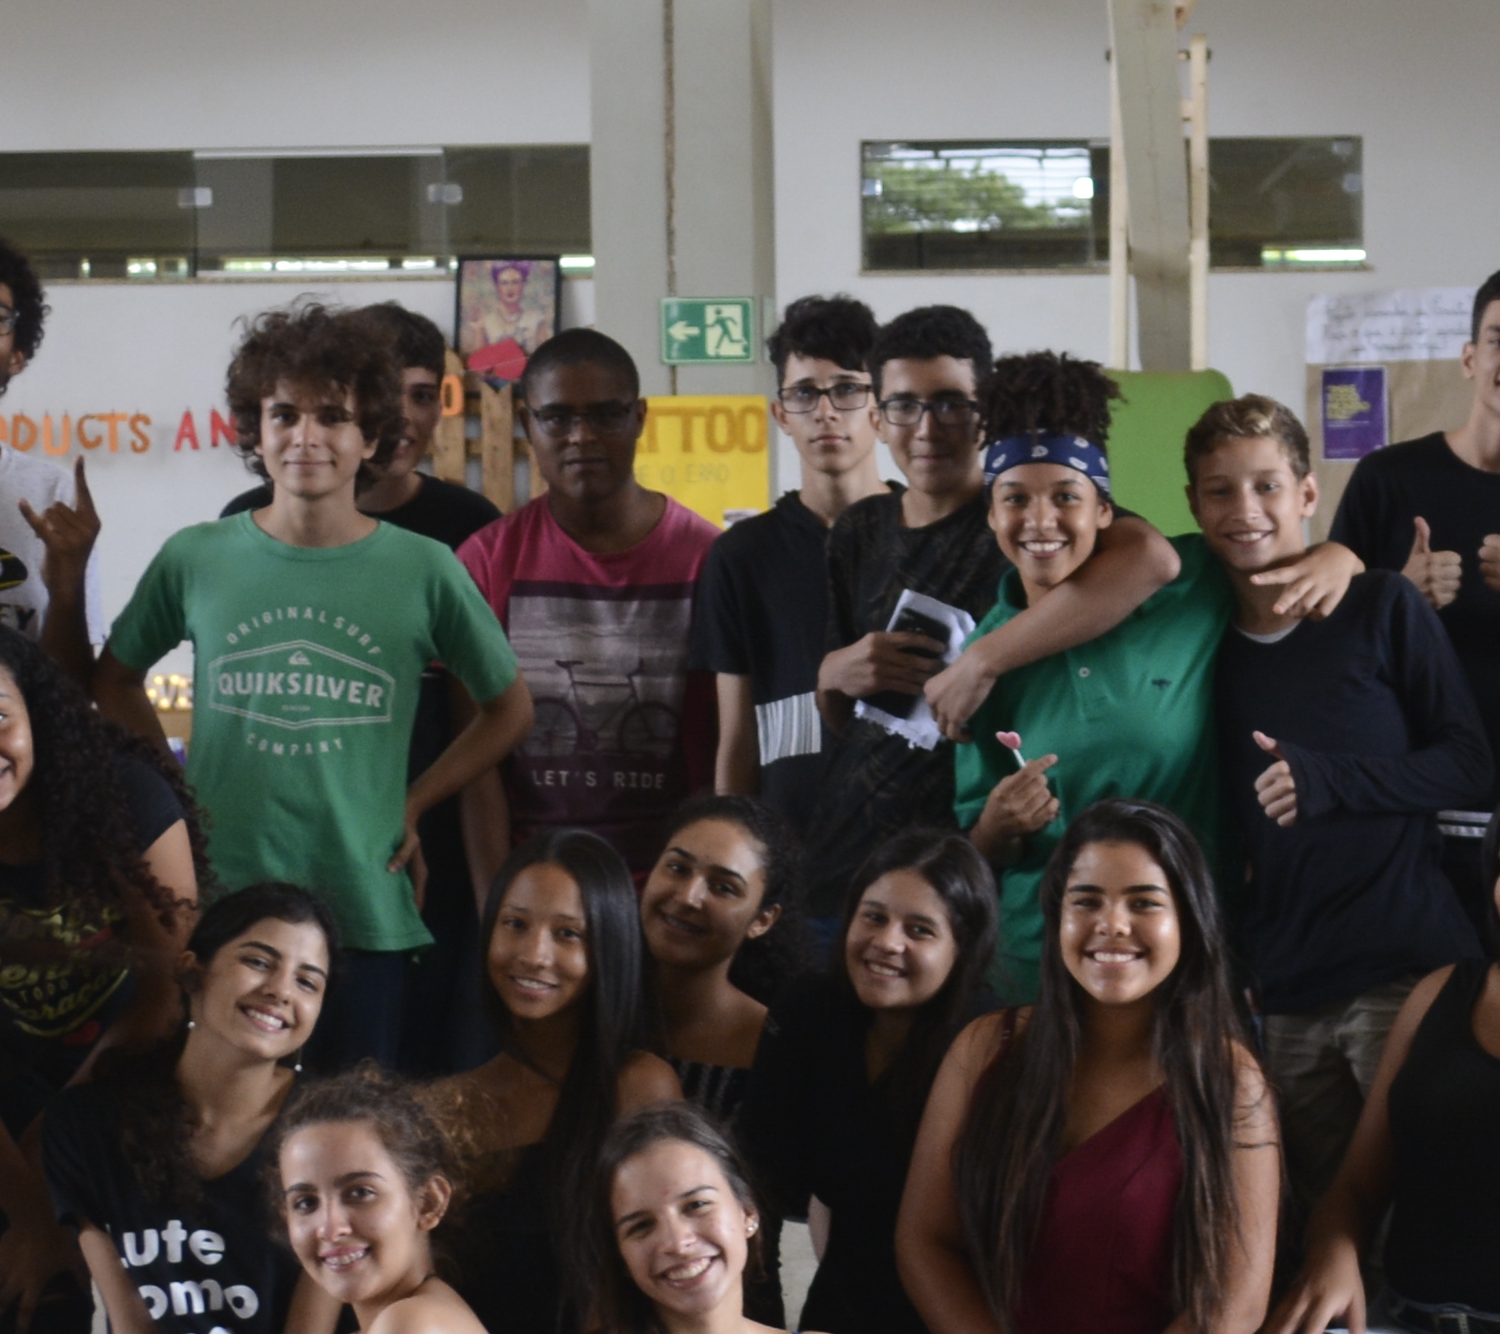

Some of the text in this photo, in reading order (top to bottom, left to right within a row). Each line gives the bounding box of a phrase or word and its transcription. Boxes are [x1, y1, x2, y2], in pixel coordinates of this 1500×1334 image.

[226, 606, 328, 645] ORIGINAL
[217, 671, 384, 708] QUIKSILVER
[246, 732, 343, 756] COMPANY
[532, 770, 667, 789] LET'S RIDE
[106, 1219, 226, 1268] ute
[138, 1279, 260, 1320] omo
